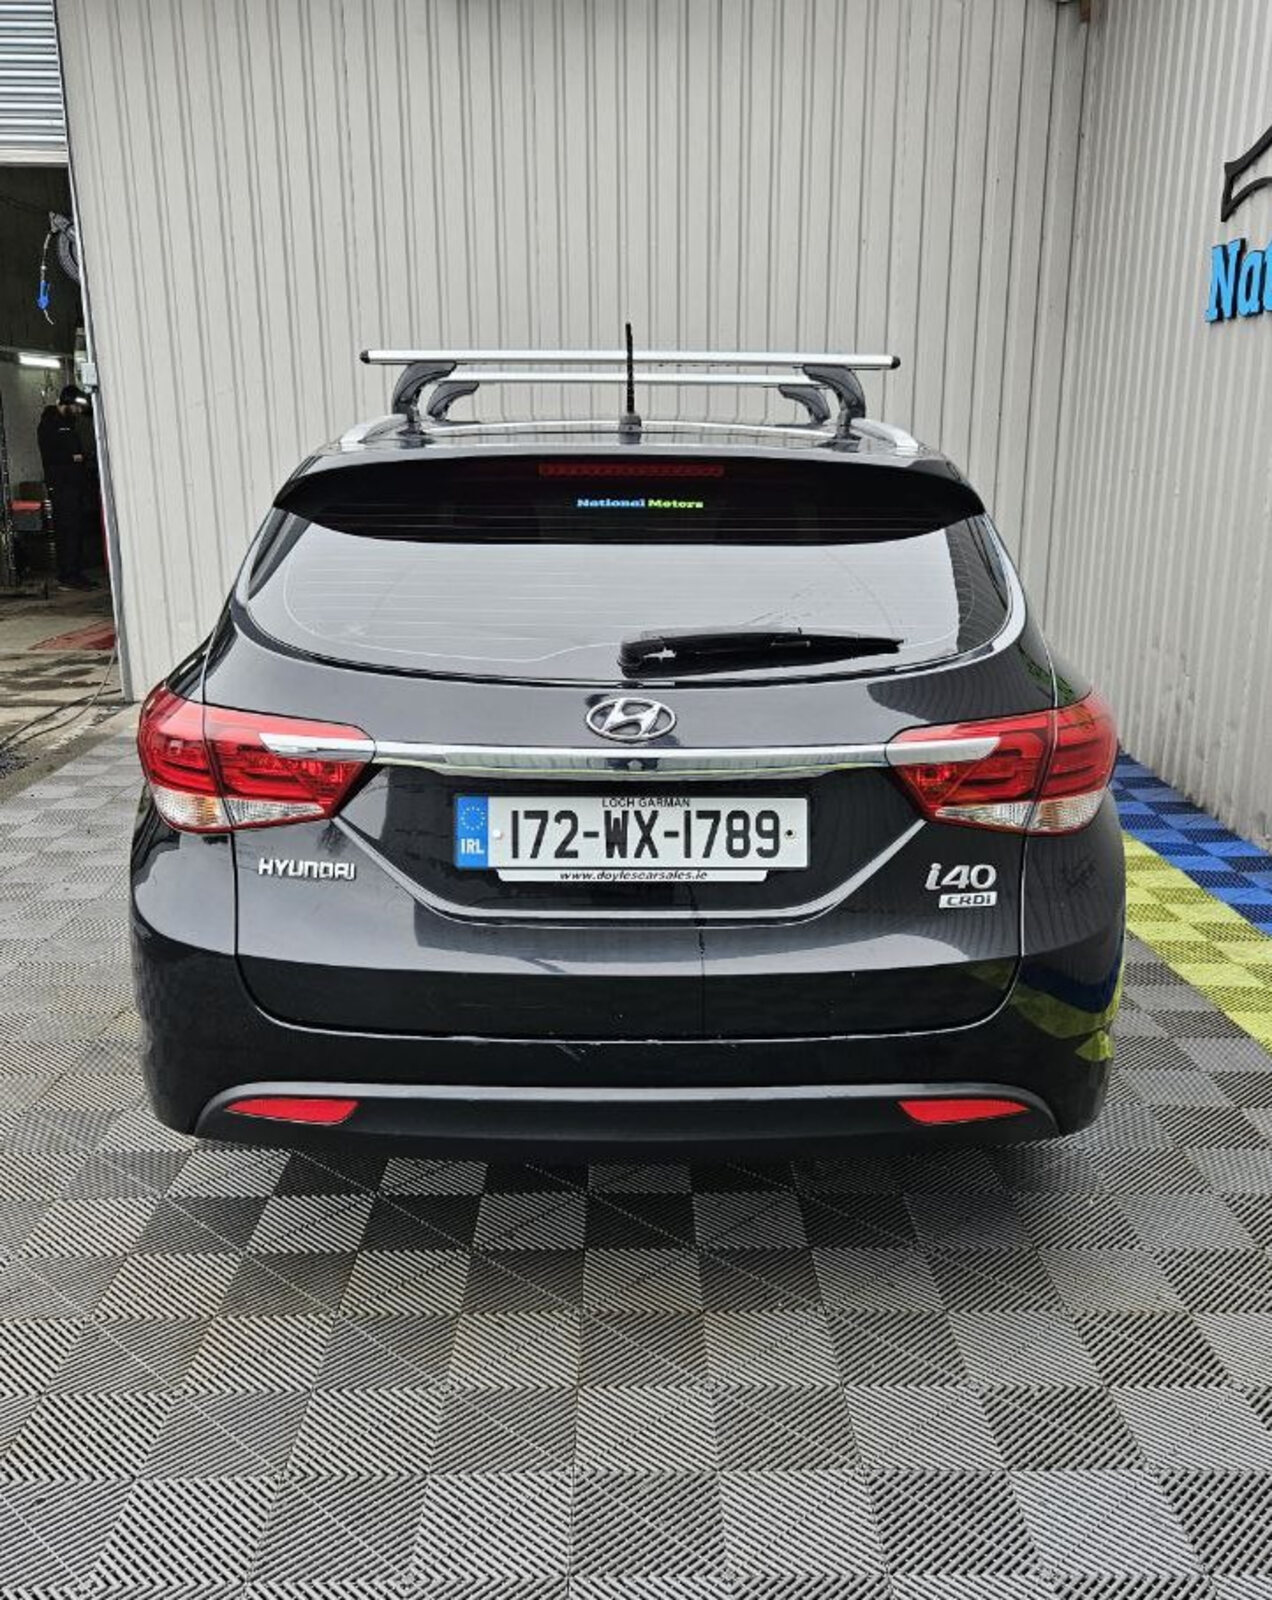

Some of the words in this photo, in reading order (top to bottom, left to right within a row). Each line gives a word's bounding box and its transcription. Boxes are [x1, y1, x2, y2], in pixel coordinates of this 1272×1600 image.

[576, 498, 646, 508] National
[648, 499, 704, 509] Motors
[602, 796, 635, 808] LOCH
[639, 796, 690, 808] GARMAN
[510, 809, 781, 860] 172-WX-1789
[461, 838, 485, 855] IRL
[258, 857, 356, 880] HYUNDAI
[559, 869, 708, 882] www.doylescarsales.ie
[924, 862, 997, 890] i40
[946, 893, 991, 907] CRDi
